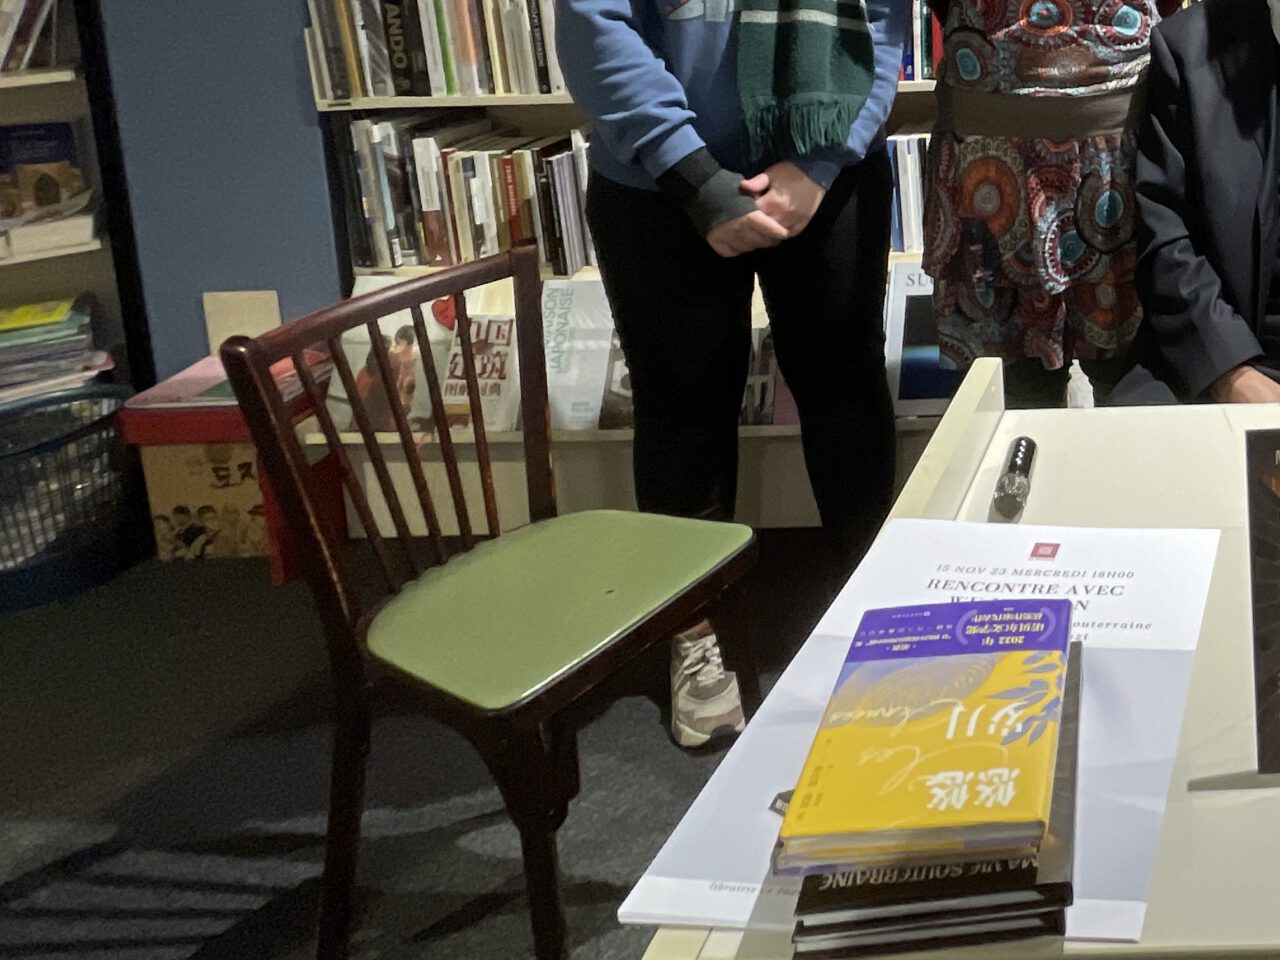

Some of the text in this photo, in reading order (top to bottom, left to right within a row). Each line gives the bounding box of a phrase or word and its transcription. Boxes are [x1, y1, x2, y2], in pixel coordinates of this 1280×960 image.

[384, 2, 409, 69] ANDO
[550, 288, 573, 373] JAPONAISE
[936, 564, 952, 573] 15
[954, 565, 987, 575] NOV
[989, 566, 1008, 576] 23
[1010, 568, 1088, 579] MERCREDI
[927, 578, 1126, 597] RENCONTRE AVEC
[1072, 620, 1152, 632] outerraine
[927, 769, 1021, 812] 悠悠
[818, 865, 964, 892] SOUTERRAINE
